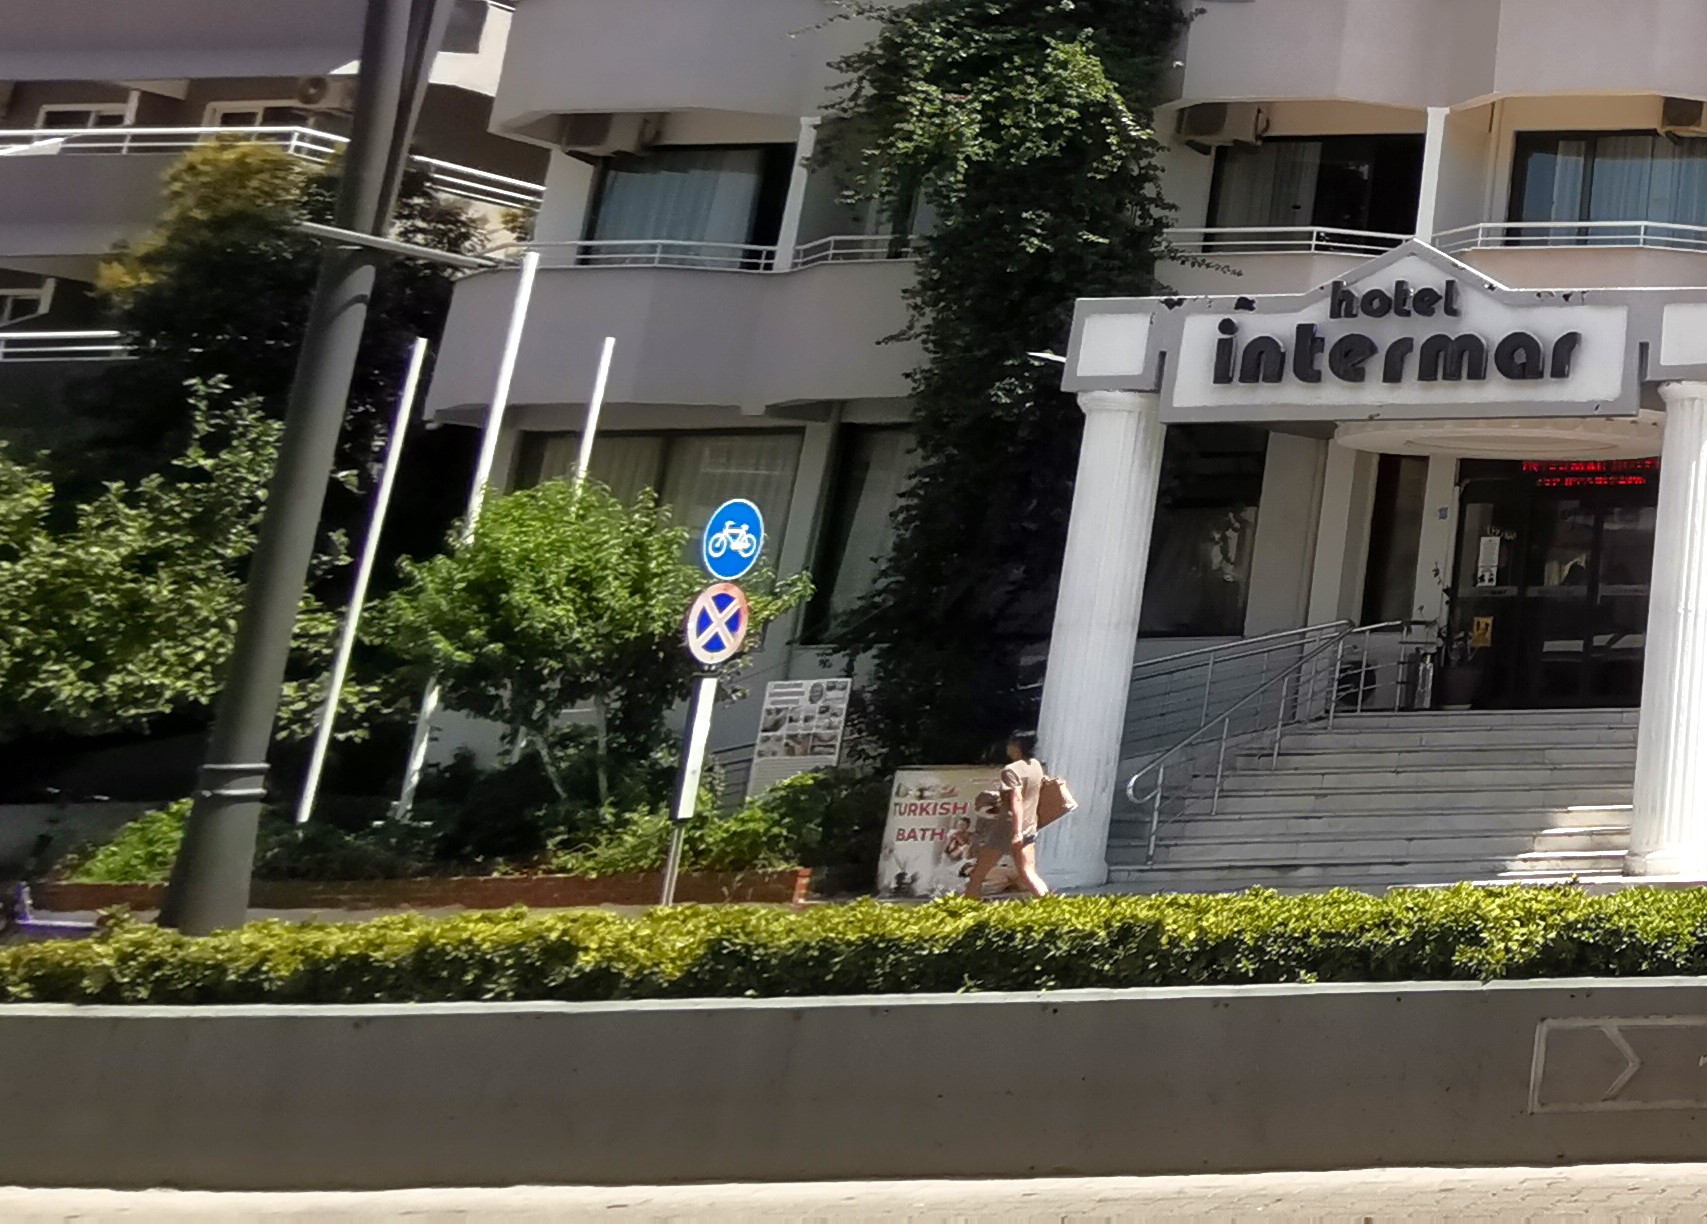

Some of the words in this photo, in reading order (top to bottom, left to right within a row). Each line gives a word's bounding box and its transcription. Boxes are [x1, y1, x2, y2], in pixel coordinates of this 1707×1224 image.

[1329, 279, 1460, 319] hotel
[1213, 317, 1582, 384] intermar
[893, 802, 968, 817] TURKISH
[895, 828, 945, 842] BATH
